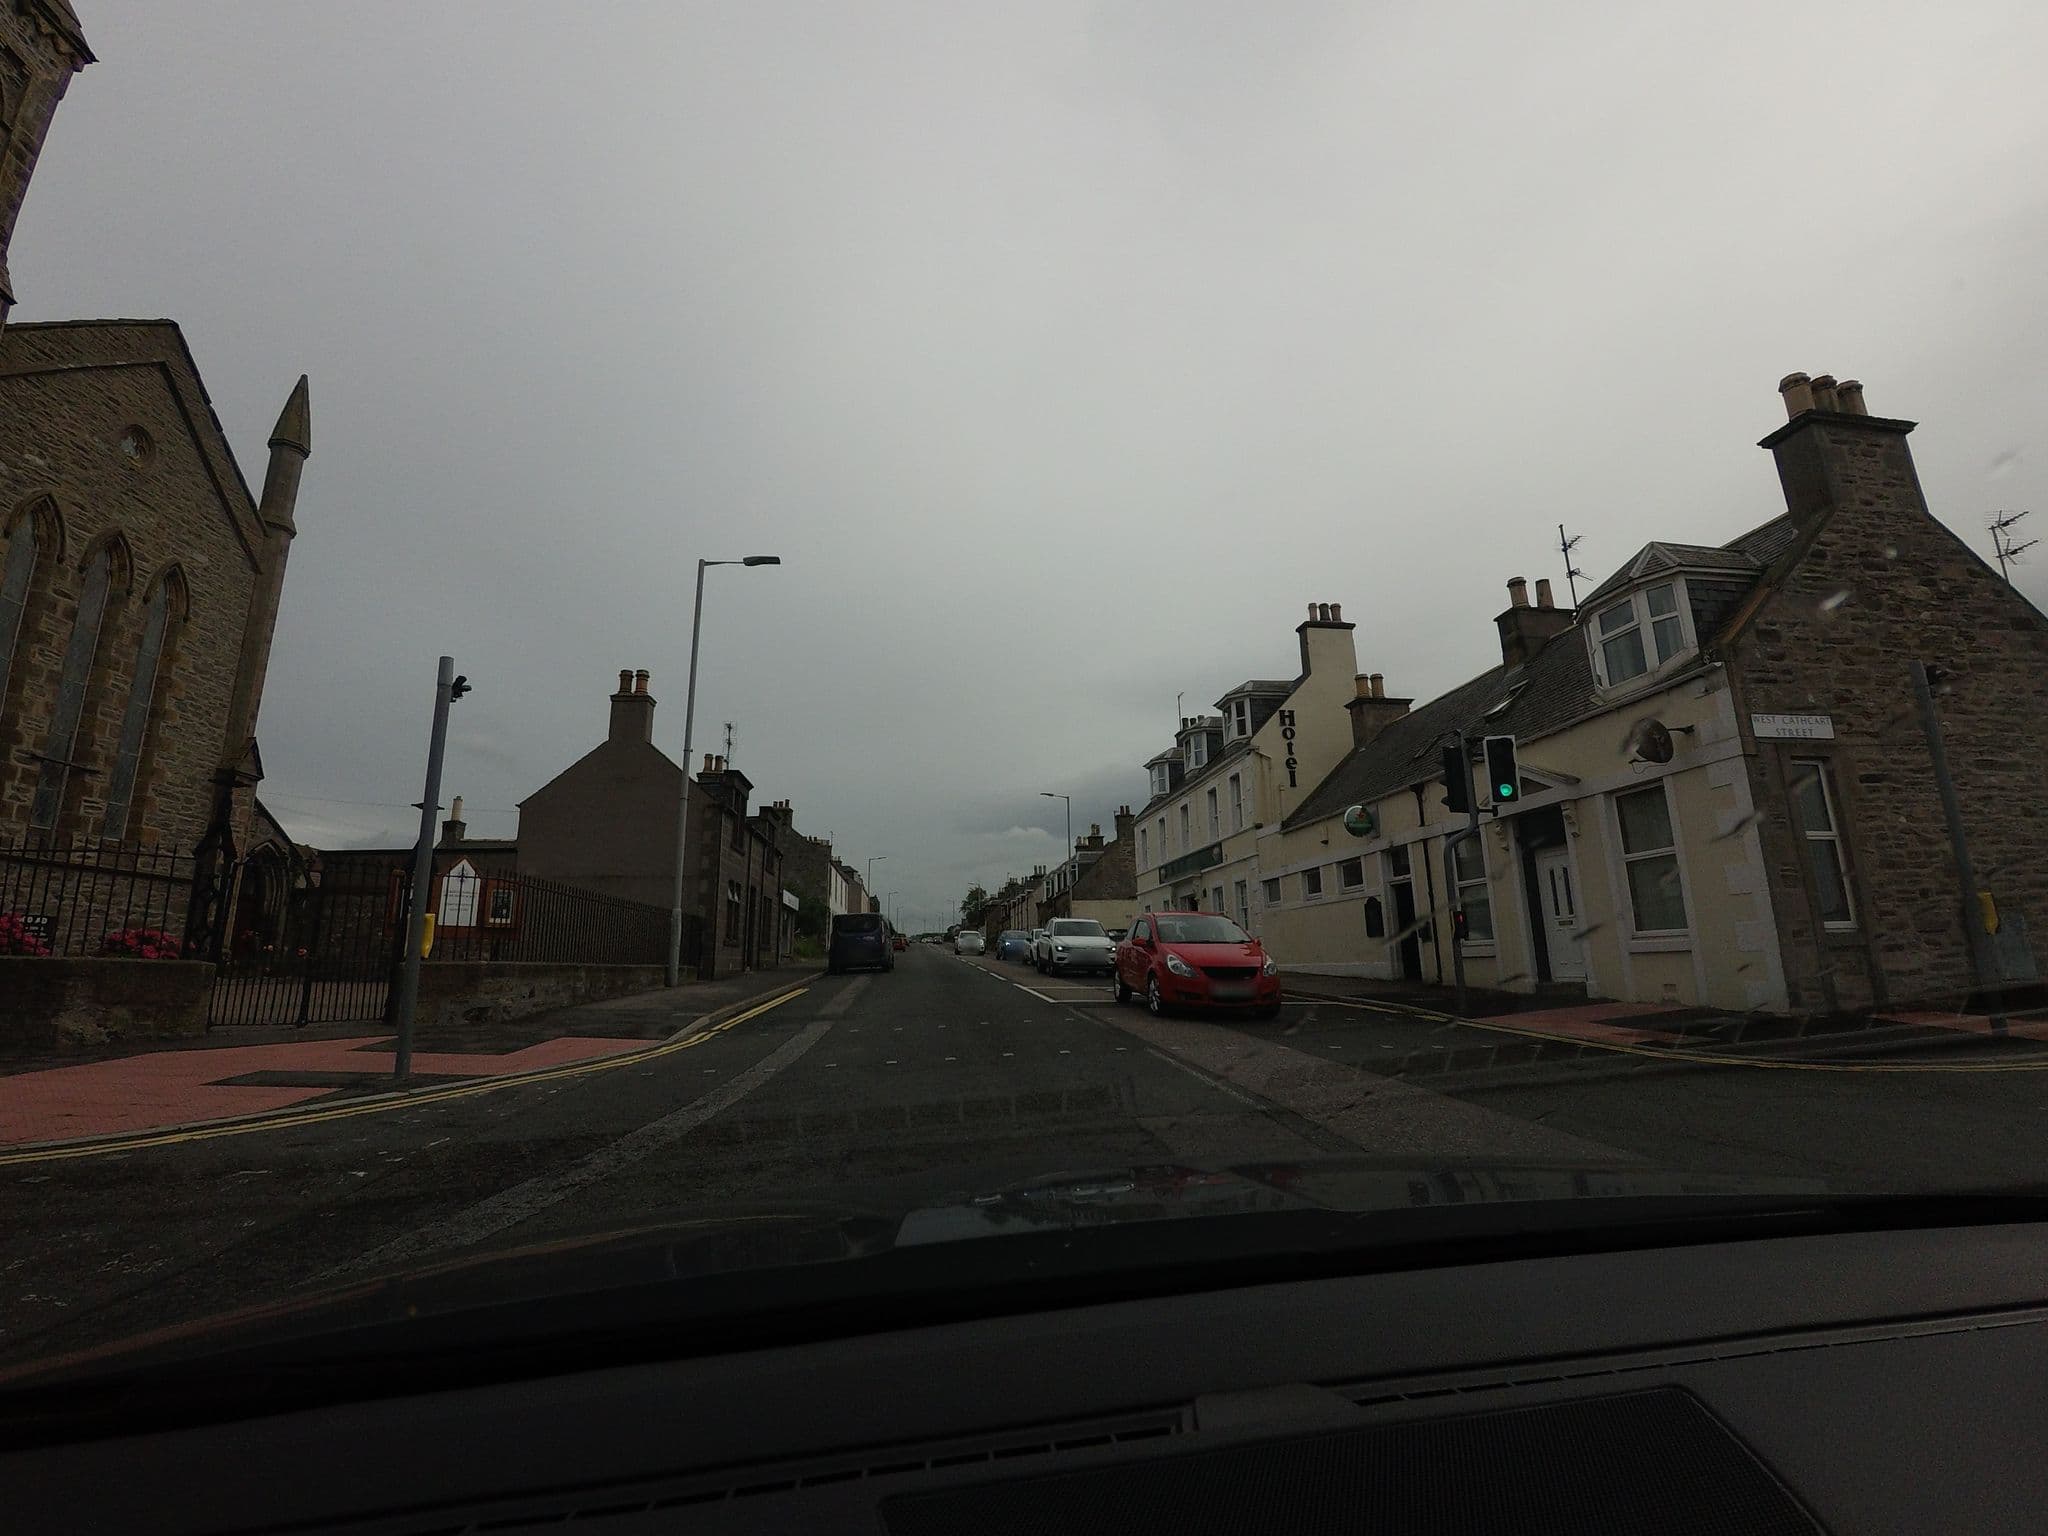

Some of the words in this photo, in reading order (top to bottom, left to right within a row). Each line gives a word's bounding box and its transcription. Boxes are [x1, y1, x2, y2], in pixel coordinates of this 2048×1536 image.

[1752, 715, 1776, 724] WEST
[1782, 716, 1831, 726] CATHCART
[1775, 728, 1814, 737] STREET
[1279, 709, 1297, 787] Hotel
